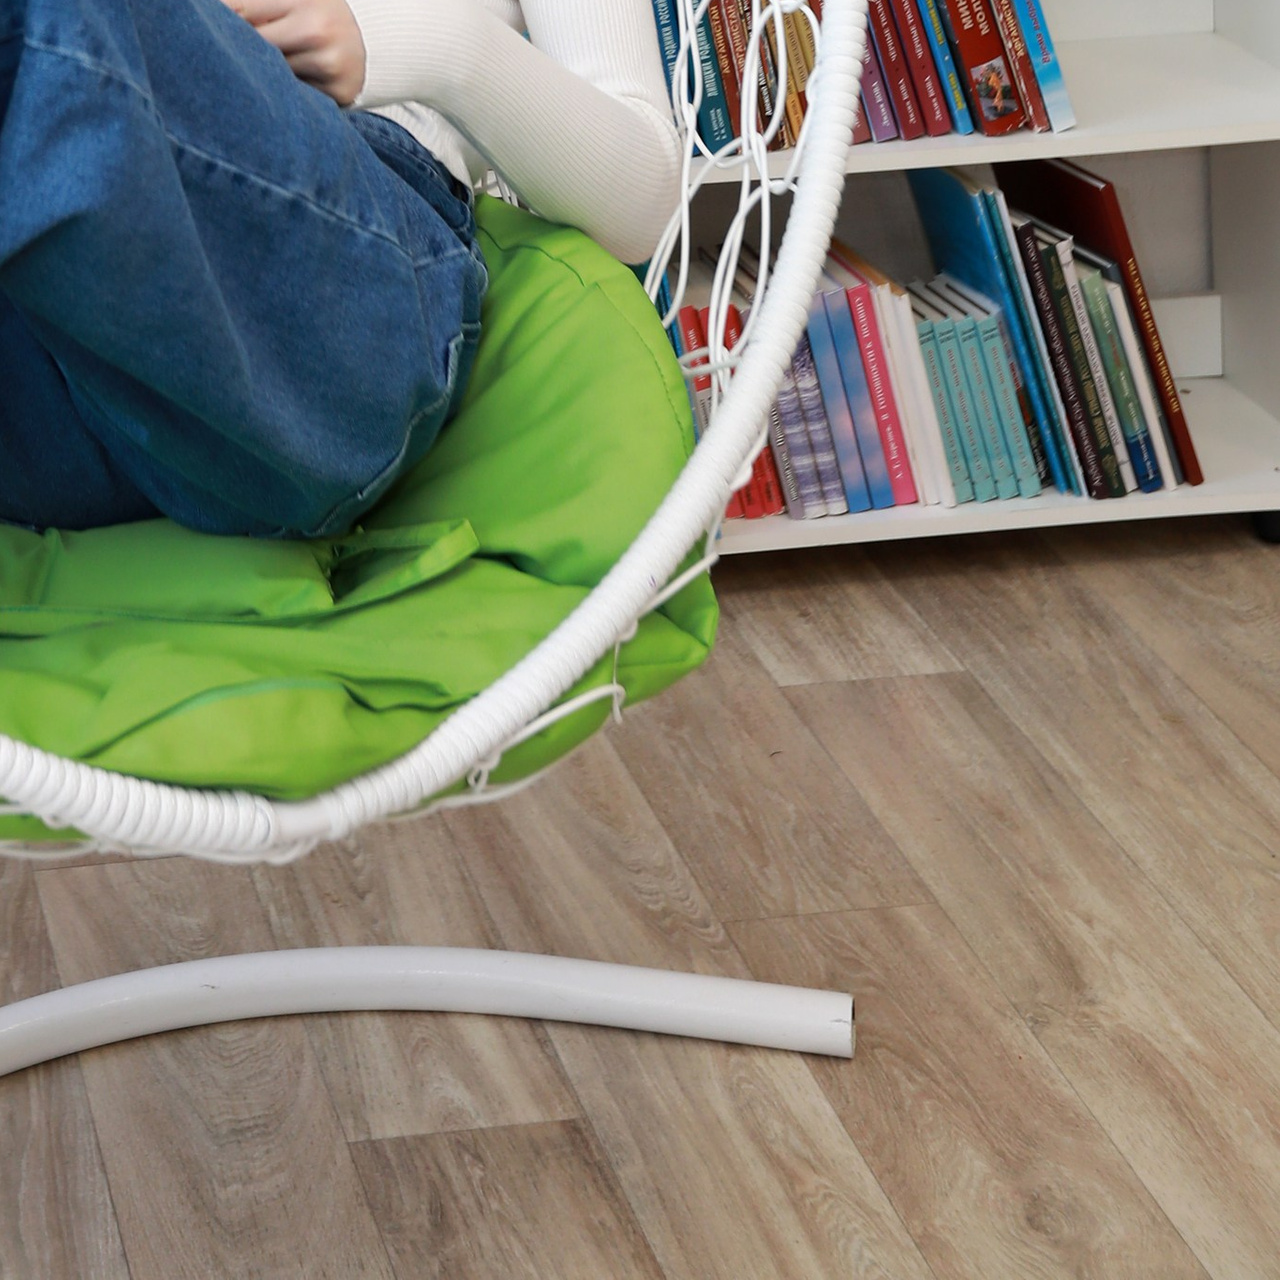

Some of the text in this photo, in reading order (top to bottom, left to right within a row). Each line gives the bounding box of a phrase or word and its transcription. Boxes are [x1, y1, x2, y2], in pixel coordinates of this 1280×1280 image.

[661, 25, 678, 60] РОДНИКИ
[709, 4, 731, 75] АФГАНИСТАН
[1034, 32, 1052, 64] Время
[696, 25, 719, 97] ЛИПЕЦКИЕ РОДНИКИ
[871, 80, 884, 102] БОВА
[898, 77, 911, 100] БОВА
[925, 75, 936, 97] БОВА
